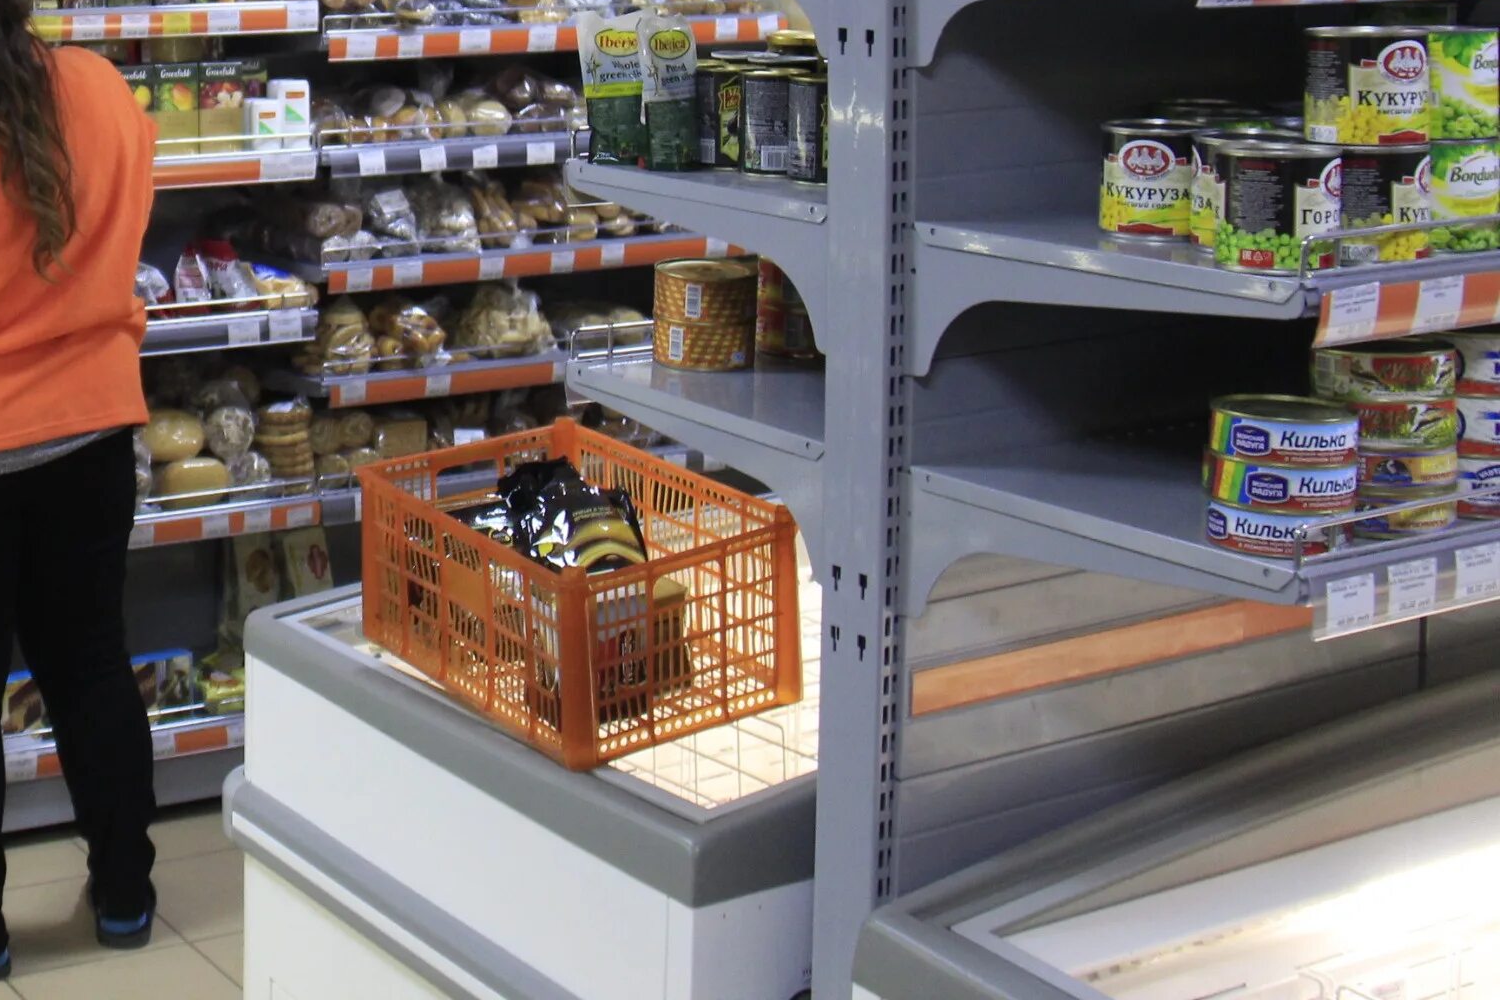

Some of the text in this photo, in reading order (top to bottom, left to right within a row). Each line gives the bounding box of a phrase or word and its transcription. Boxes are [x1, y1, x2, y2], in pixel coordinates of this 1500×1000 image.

[599, 35, 638, 49] Iberic
[654, 38, 686, 51] Iberica
[160, 68, 191, 79] Greenfield
[205, 66, 236, 77] Greenfield
[1357, 90, 1428, 107] КУКУРУ
[1106, 180, 1190, 202] КУКУРУЗА
[1236, 440, 1265, 450] РАДУГА
[1280, 430, 1347, 449] Килька
[1251, 487, 1284, 497] РАДУГА
[1299, 477, 1354, 495] Килька
